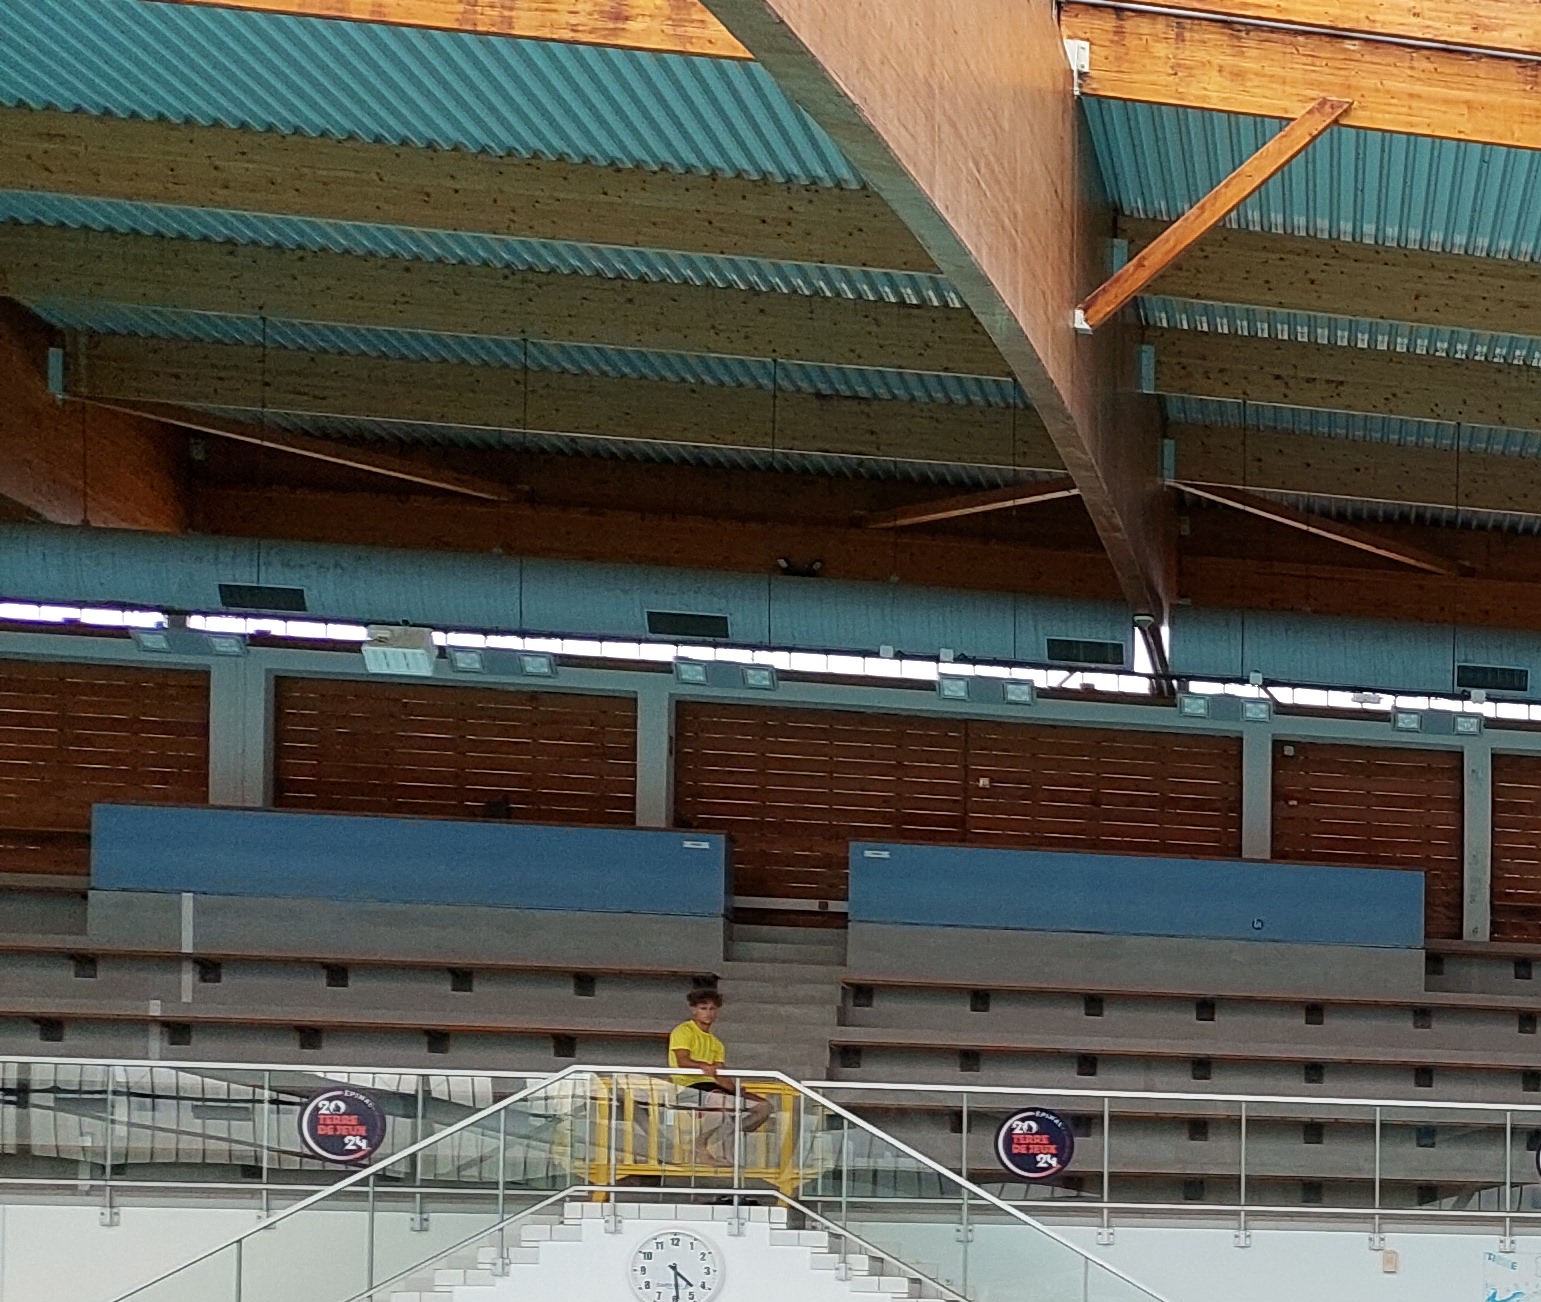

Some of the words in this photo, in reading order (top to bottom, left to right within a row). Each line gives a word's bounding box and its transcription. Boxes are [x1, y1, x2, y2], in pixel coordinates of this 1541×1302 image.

[318, 1100, 346, 1114] 20
[1011, 1121, 1039, 1133] 20
[344, 1136, 367, 1149] 24
[1035, 1154, 1057, 1167] 24
[655, 1241, 664, 1250] 11
[671, 1238, 680, 1246] 12
[690, 1242, 694, 1250] 1
[643, 1252, 652, 1260] 10
[700, 1252, 706, 1261] 2
[640, 1266, 646, 1275] 9
[704, 1267, 710, 1275] 3
[644, 1281, 650, 1289] 8
[700, 1281, 706, 1290] 4
[656, 1291, 662, 1300] 7
[688, 1292, 695, 1300] 5
